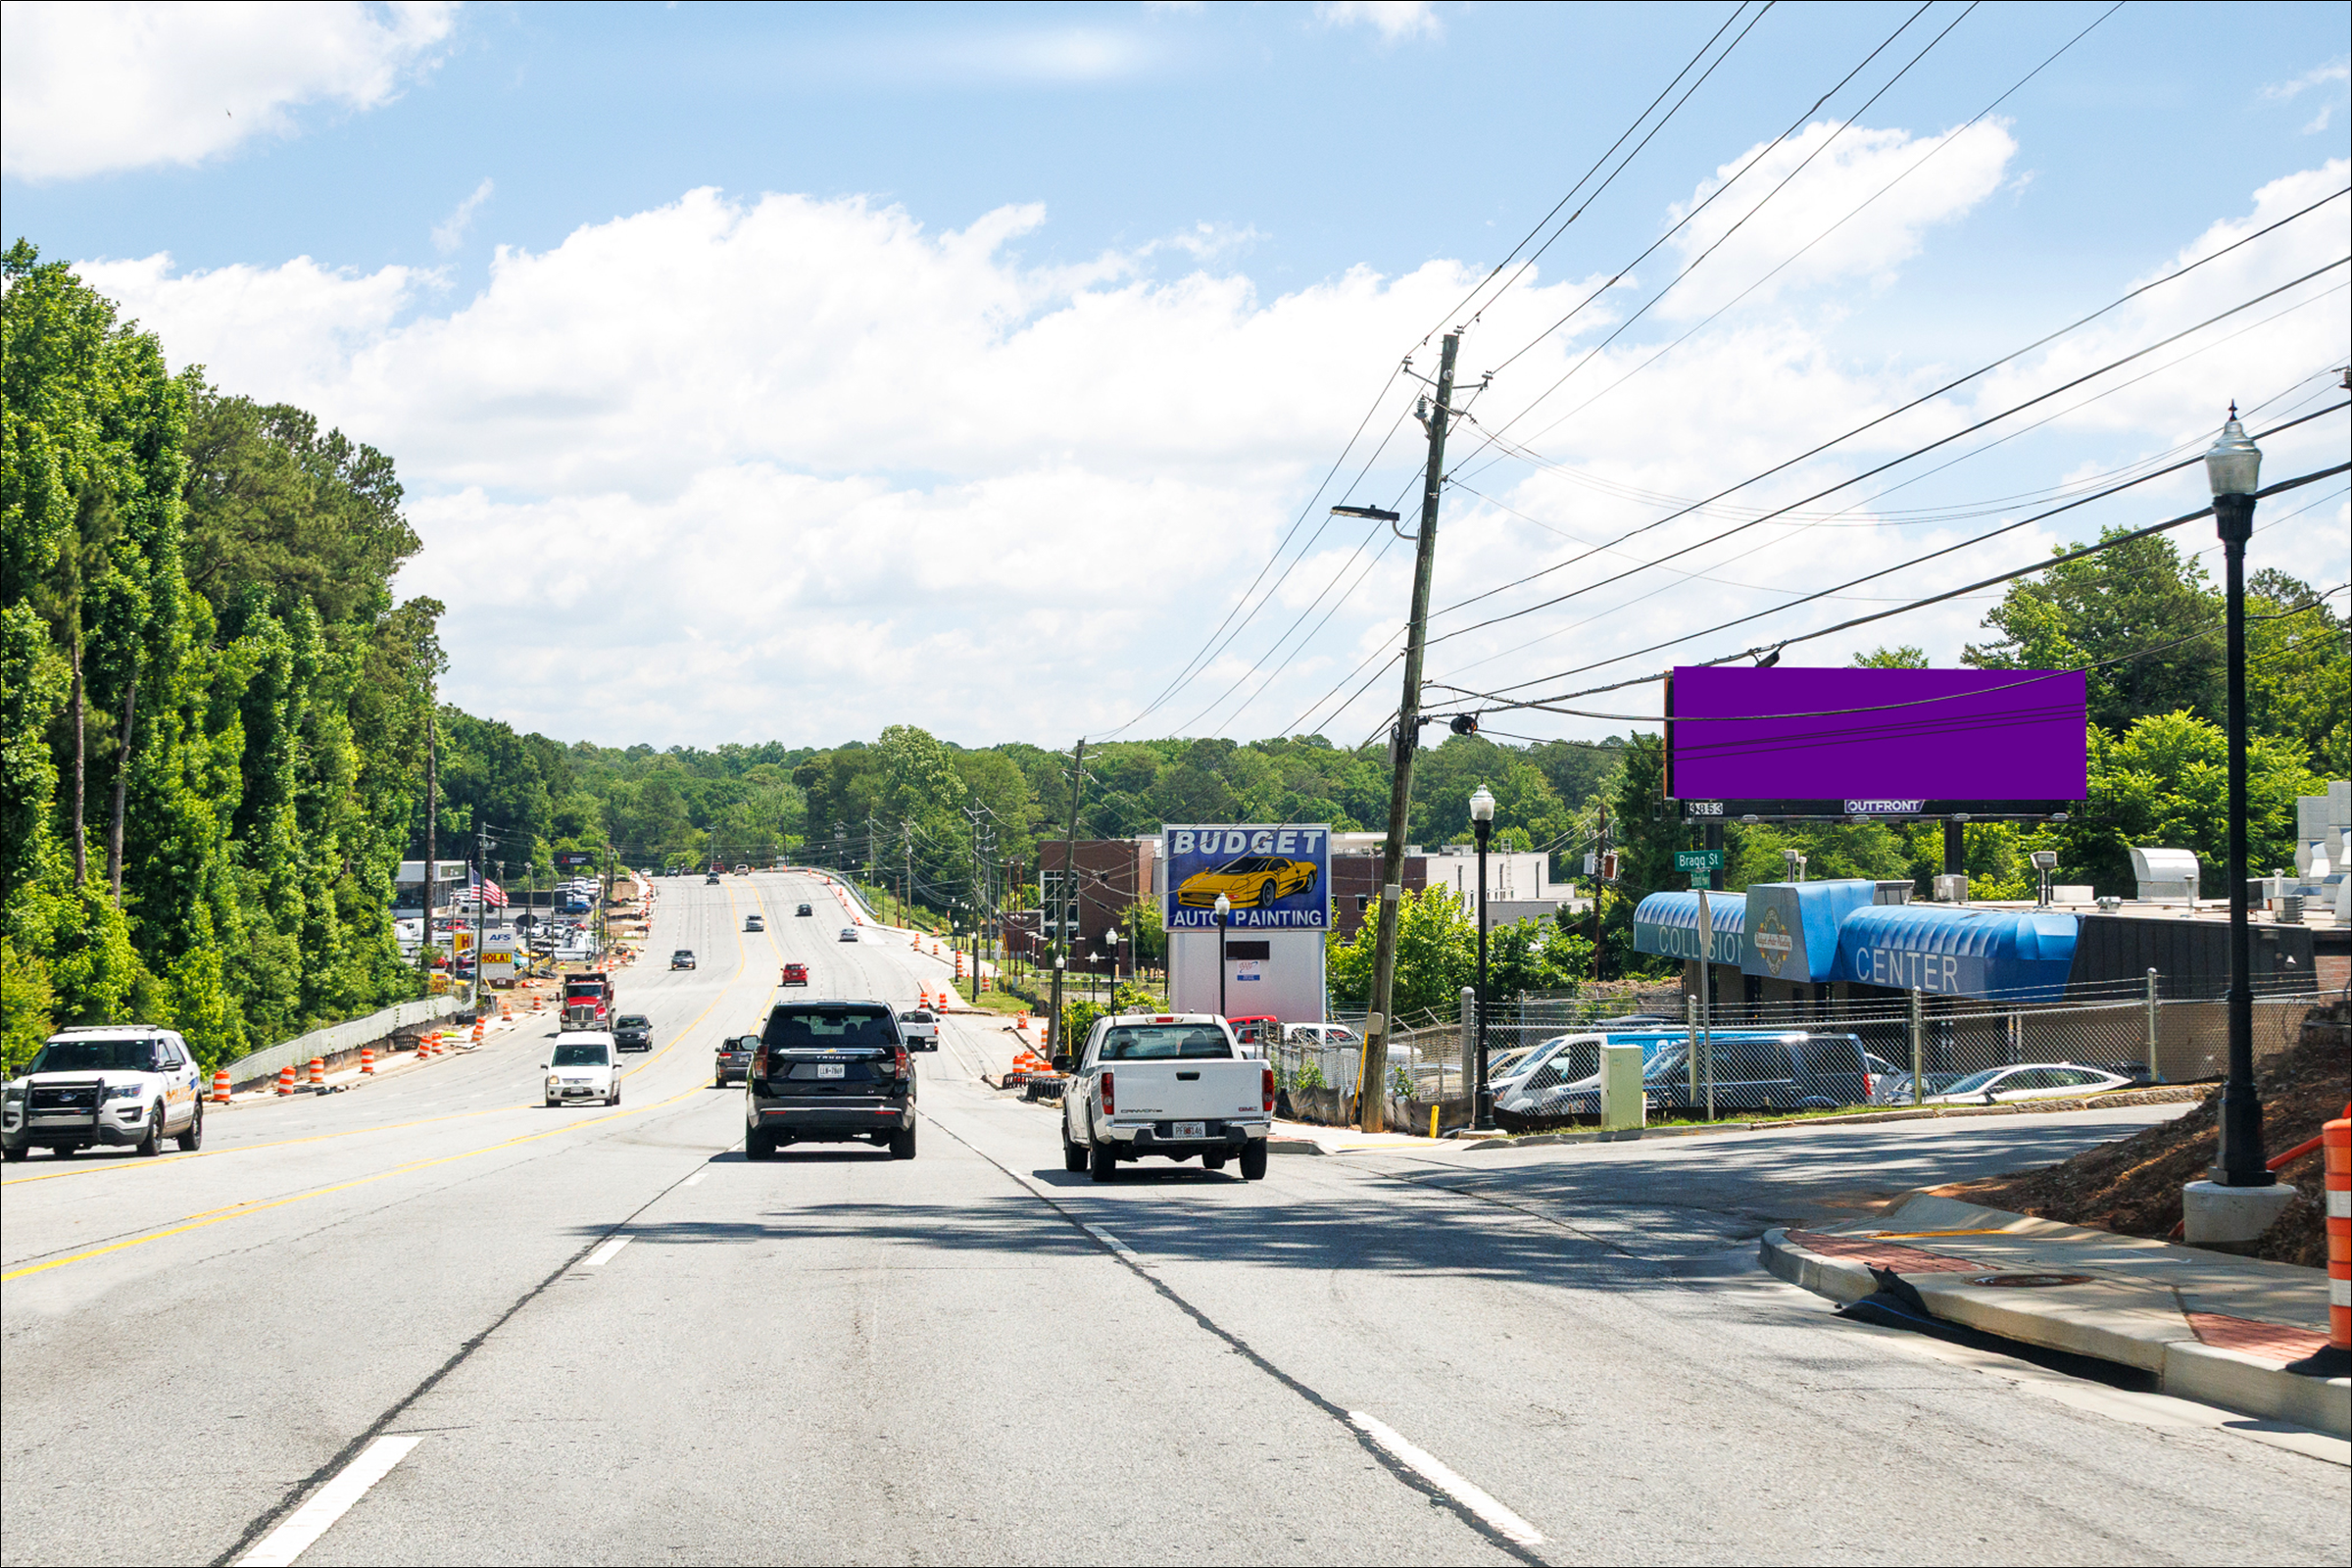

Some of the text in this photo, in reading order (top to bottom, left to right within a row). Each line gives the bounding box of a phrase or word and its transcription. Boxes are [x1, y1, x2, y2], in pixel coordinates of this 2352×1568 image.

[1847, 800, 1920, 811] OUTFRONT
[1173, 830, 1323, 855] BUDGET
[1679, 853, 1719, 868] Bragg St
[1173, 909, 1323, 926] AUTO PAINTING
[1658, 925, 1743, 964] COLLSIO
[1855, 947, 1959, 993] CENTER
